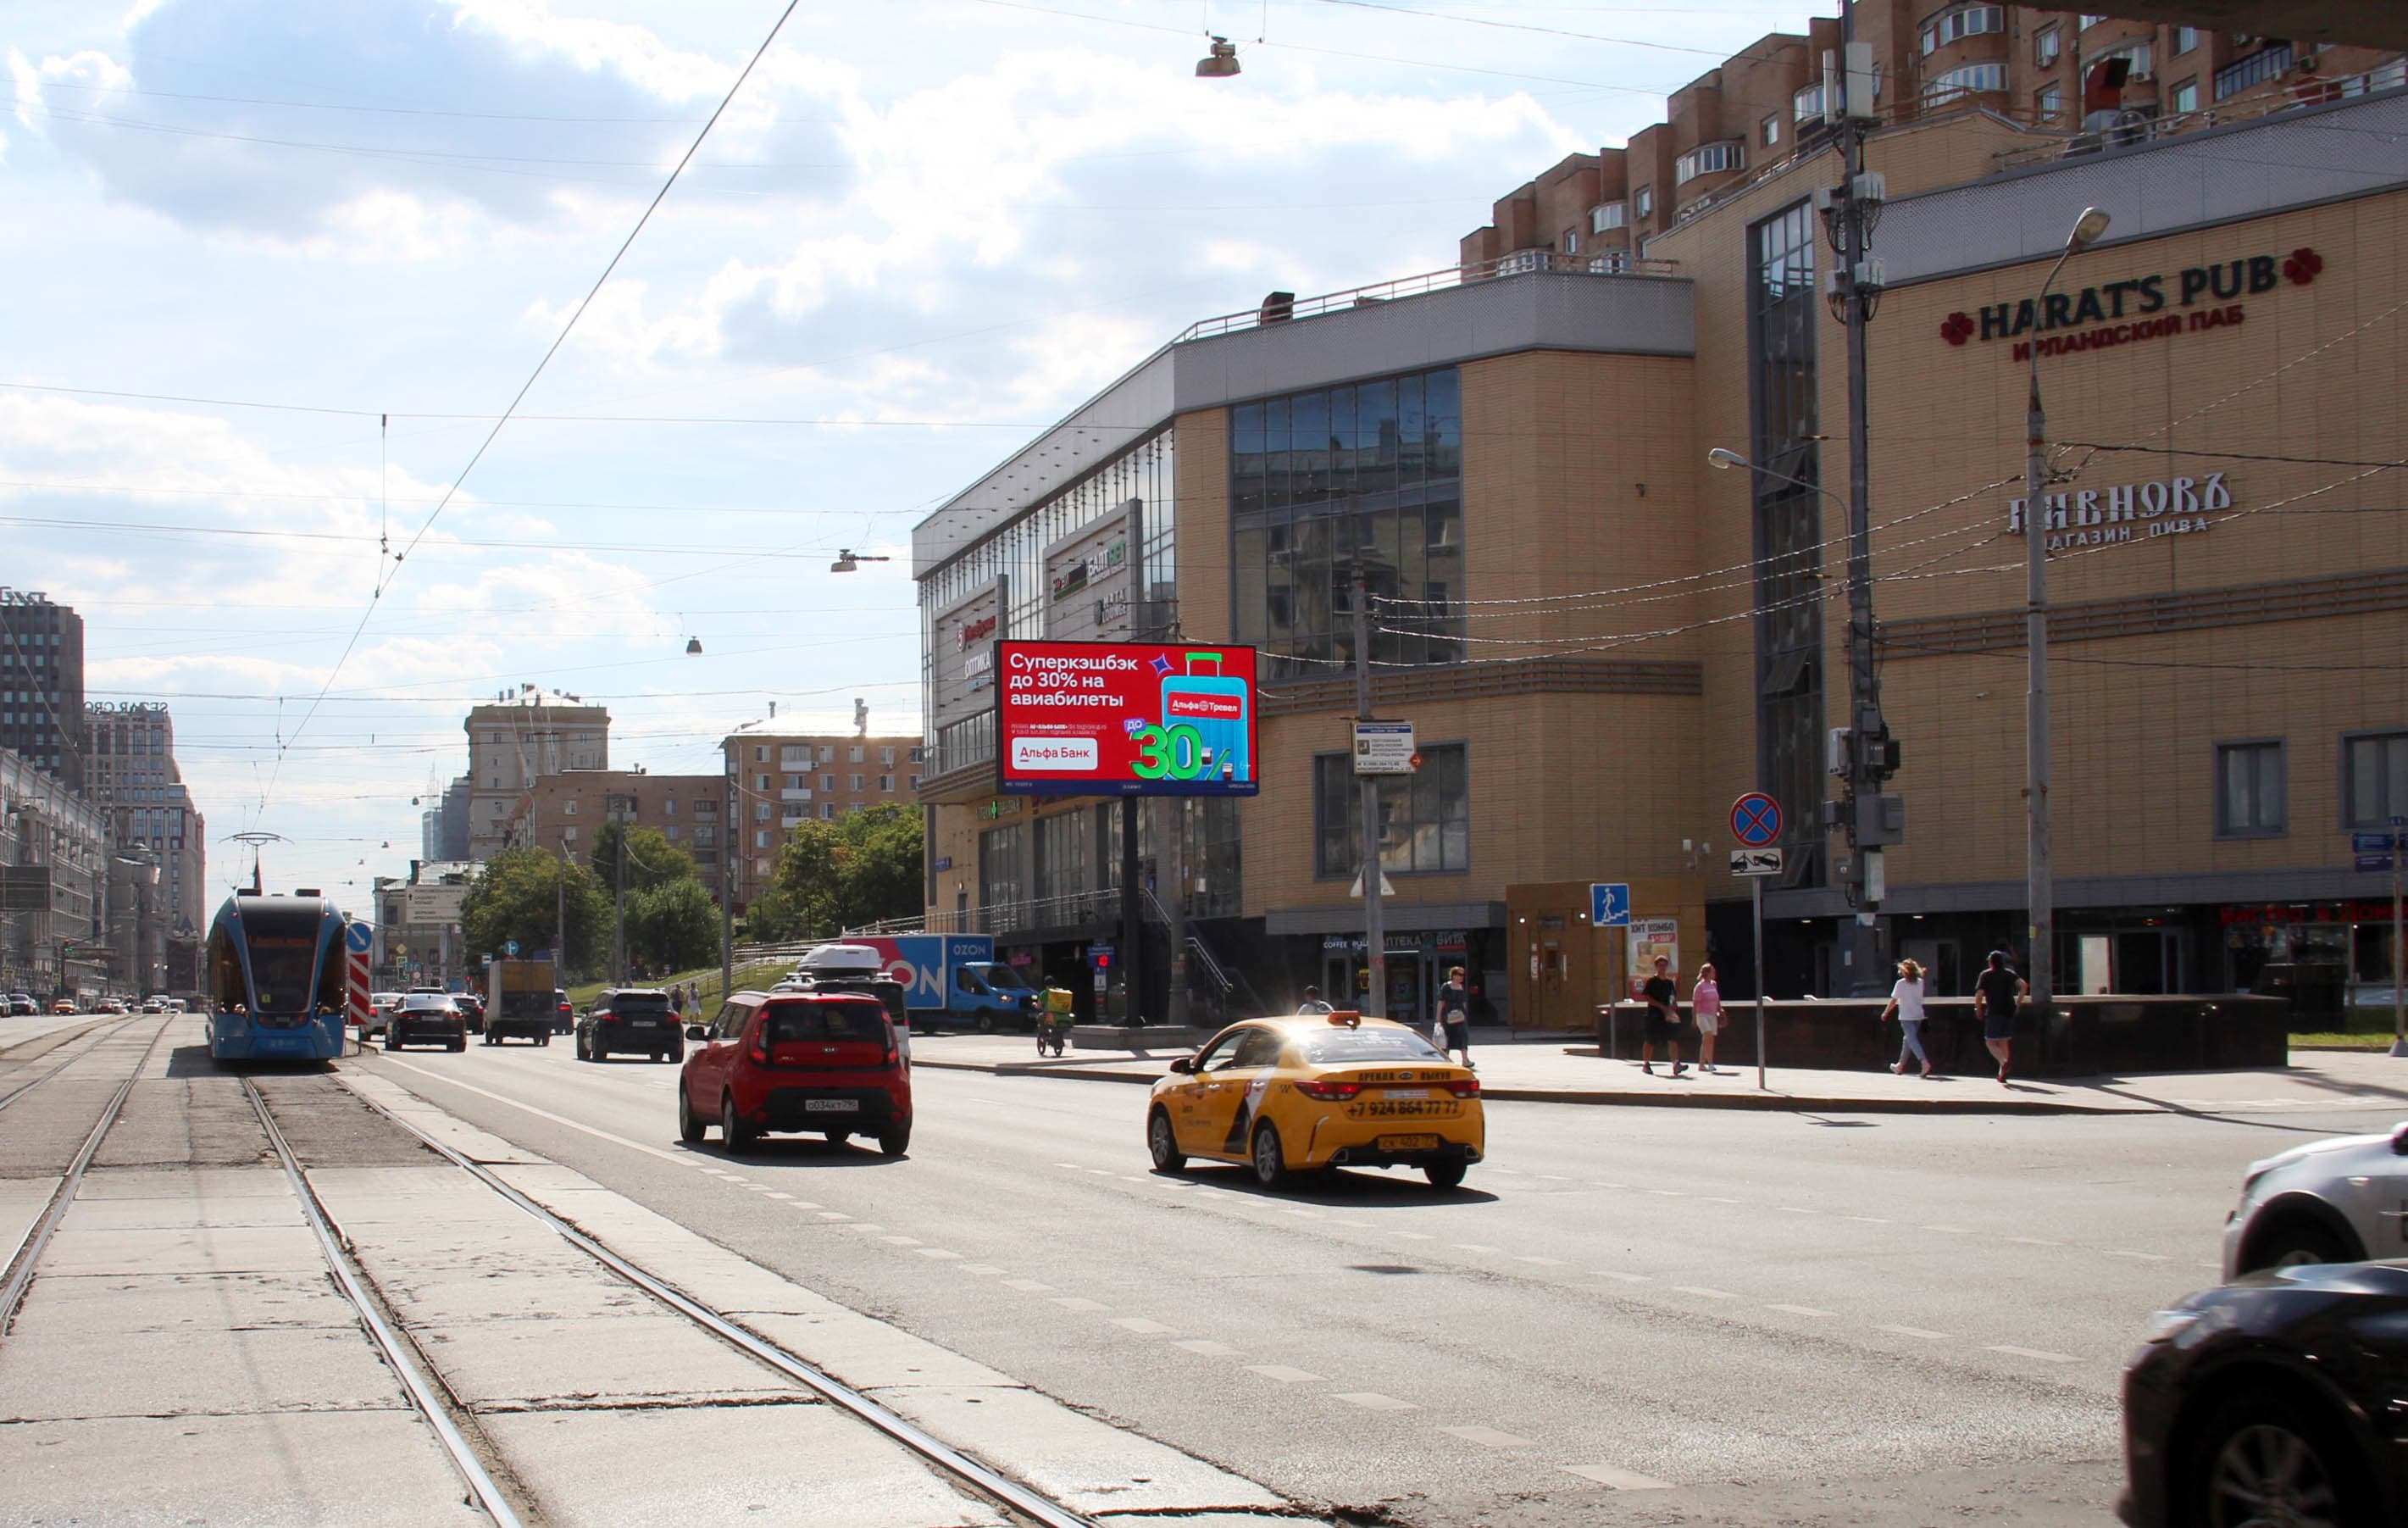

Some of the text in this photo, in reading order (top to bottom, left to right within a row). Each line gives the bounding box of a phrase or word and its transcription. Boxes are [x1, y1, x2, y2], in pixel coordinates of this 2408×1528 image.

[1979, 255, 2278, 341] HARAT'S PUB
[2189, 304, 2244, 331] ПАБ
[2044, 517, 2208, 551] АГАЗИН ПИВА
[1010, 653, 1138, 672] Суперкэшбэк
[1010, 672, 1104, 689] до 30% на
[1010, 691, 1124, 707] авиабилеты
[1127, 720, 1142, 731] до
[1019, 747, 1090, 761] Альфа Банк
[953, 945, 986, 955] OZON
